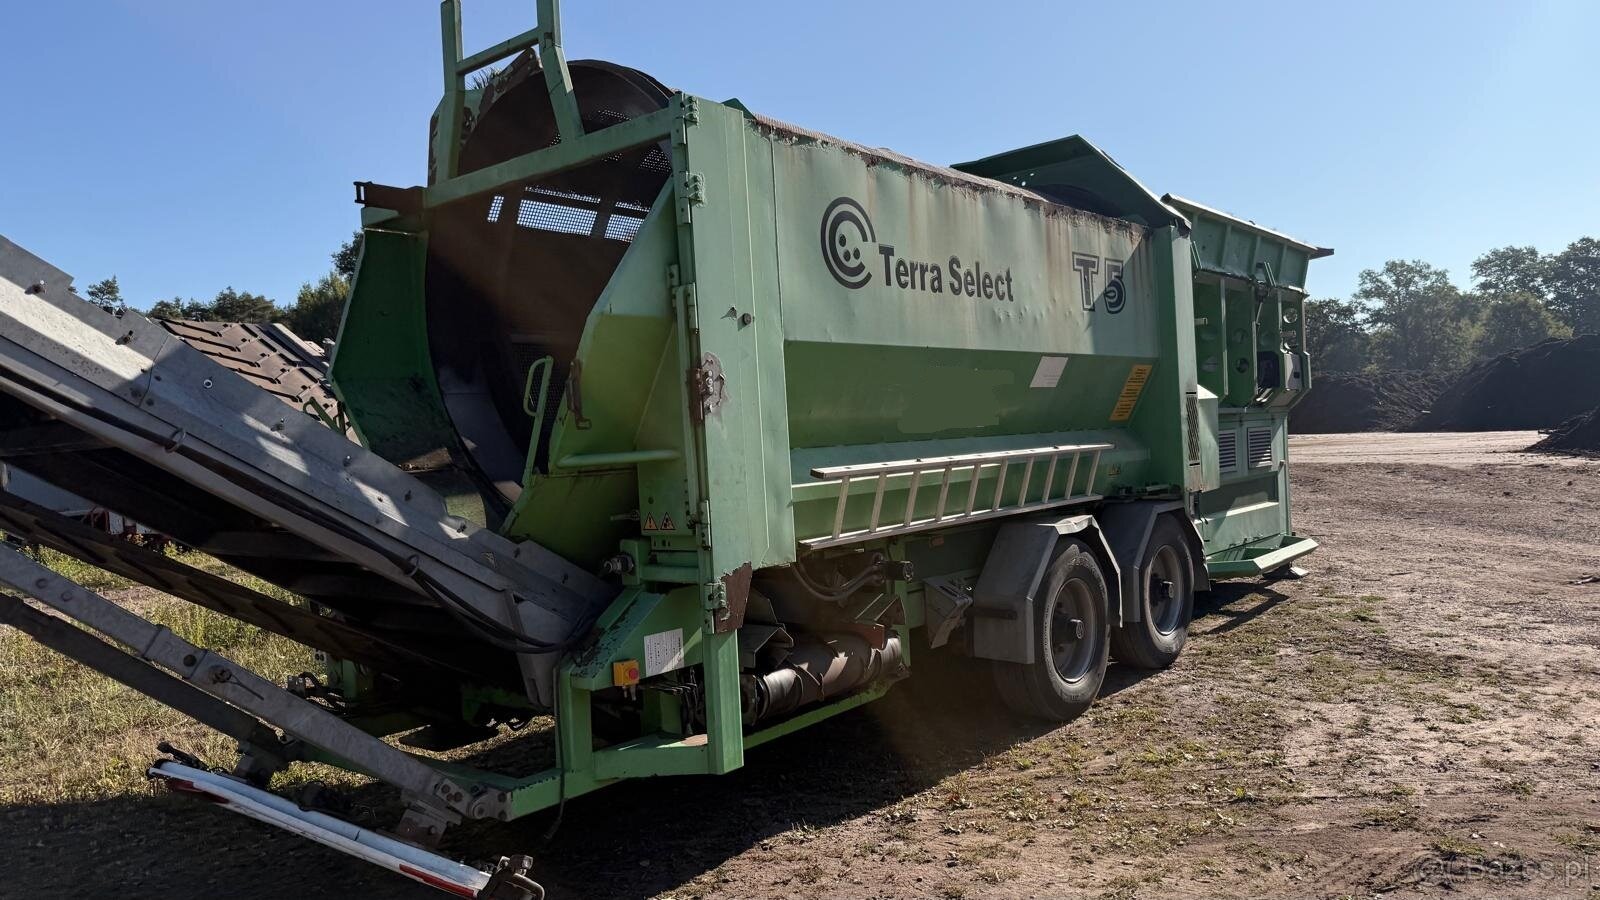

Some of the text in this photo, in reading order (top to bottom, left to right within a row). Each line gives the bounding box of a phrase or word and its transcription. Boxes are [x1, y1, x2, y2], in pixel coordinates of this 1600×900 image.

[878, 243, 1014, 302] Terra Select
[1072, 251, 1126, 314] T5
